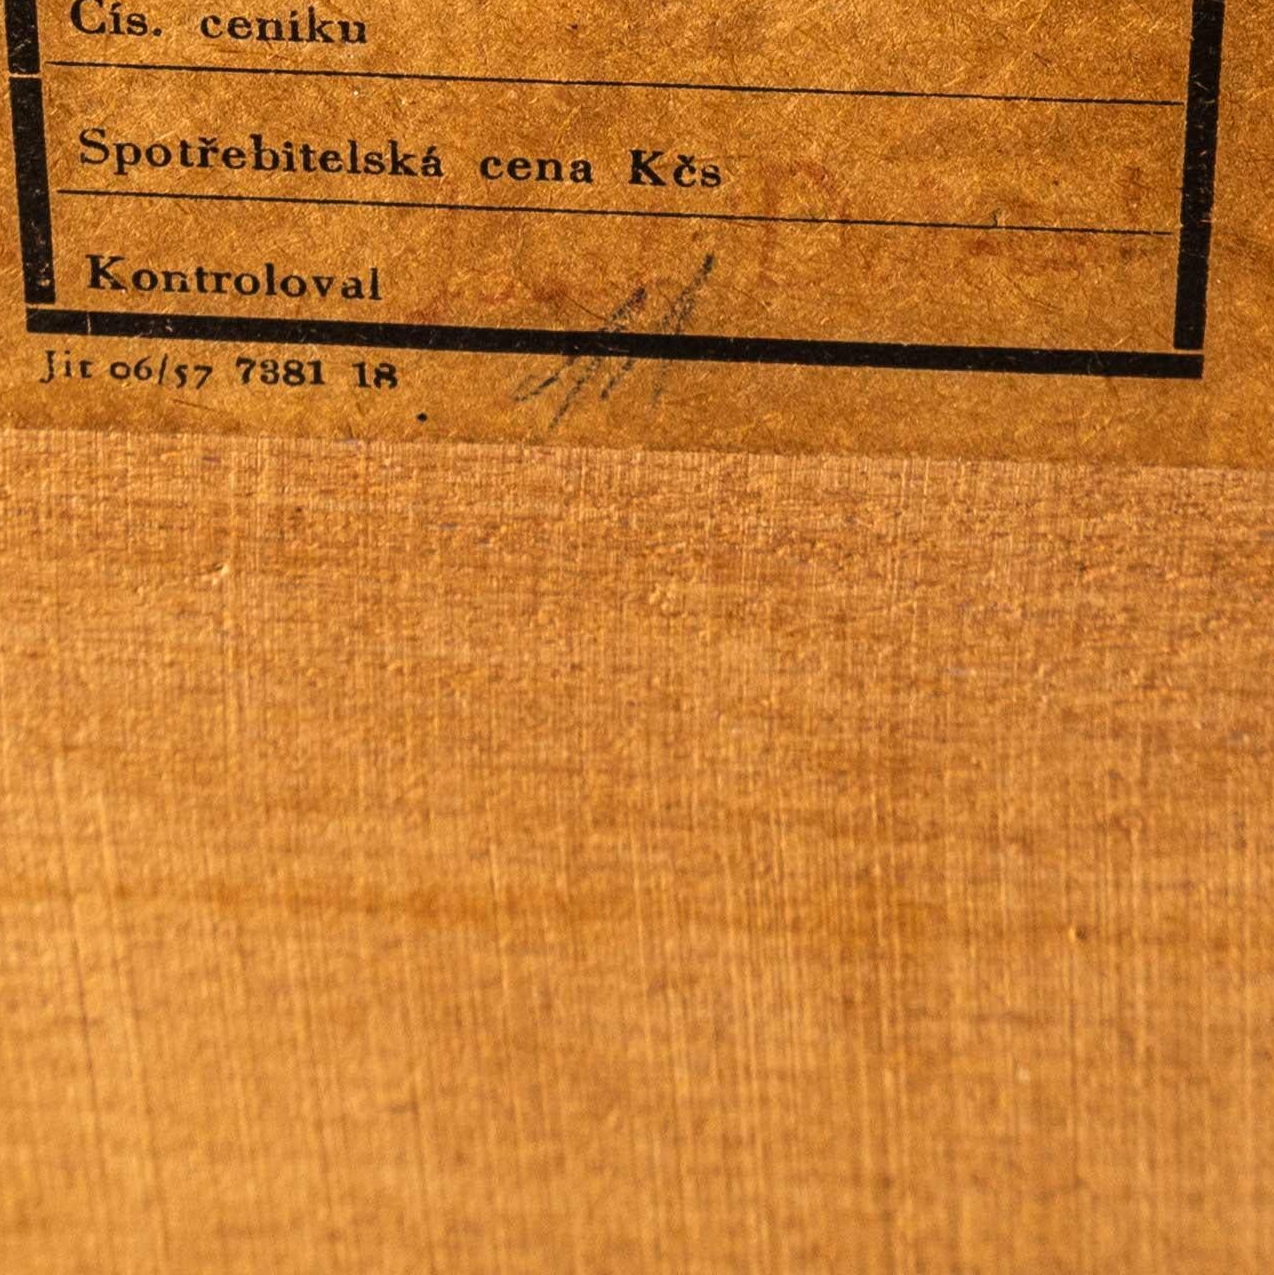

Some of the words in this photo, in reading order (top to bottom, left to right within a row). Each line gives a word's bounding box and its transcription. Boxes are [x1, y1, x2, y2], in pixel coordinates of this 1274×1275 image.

[79, 128, 443, 177] Spotřebitelská
[480, 157, 593, 183] cena
[628, 149, 721, 187] Kčs
[88, 254, 380, 300] Kontroloval
[110, 359, 213, 387] 06/57
[236, 358, 322, 385] 7381
